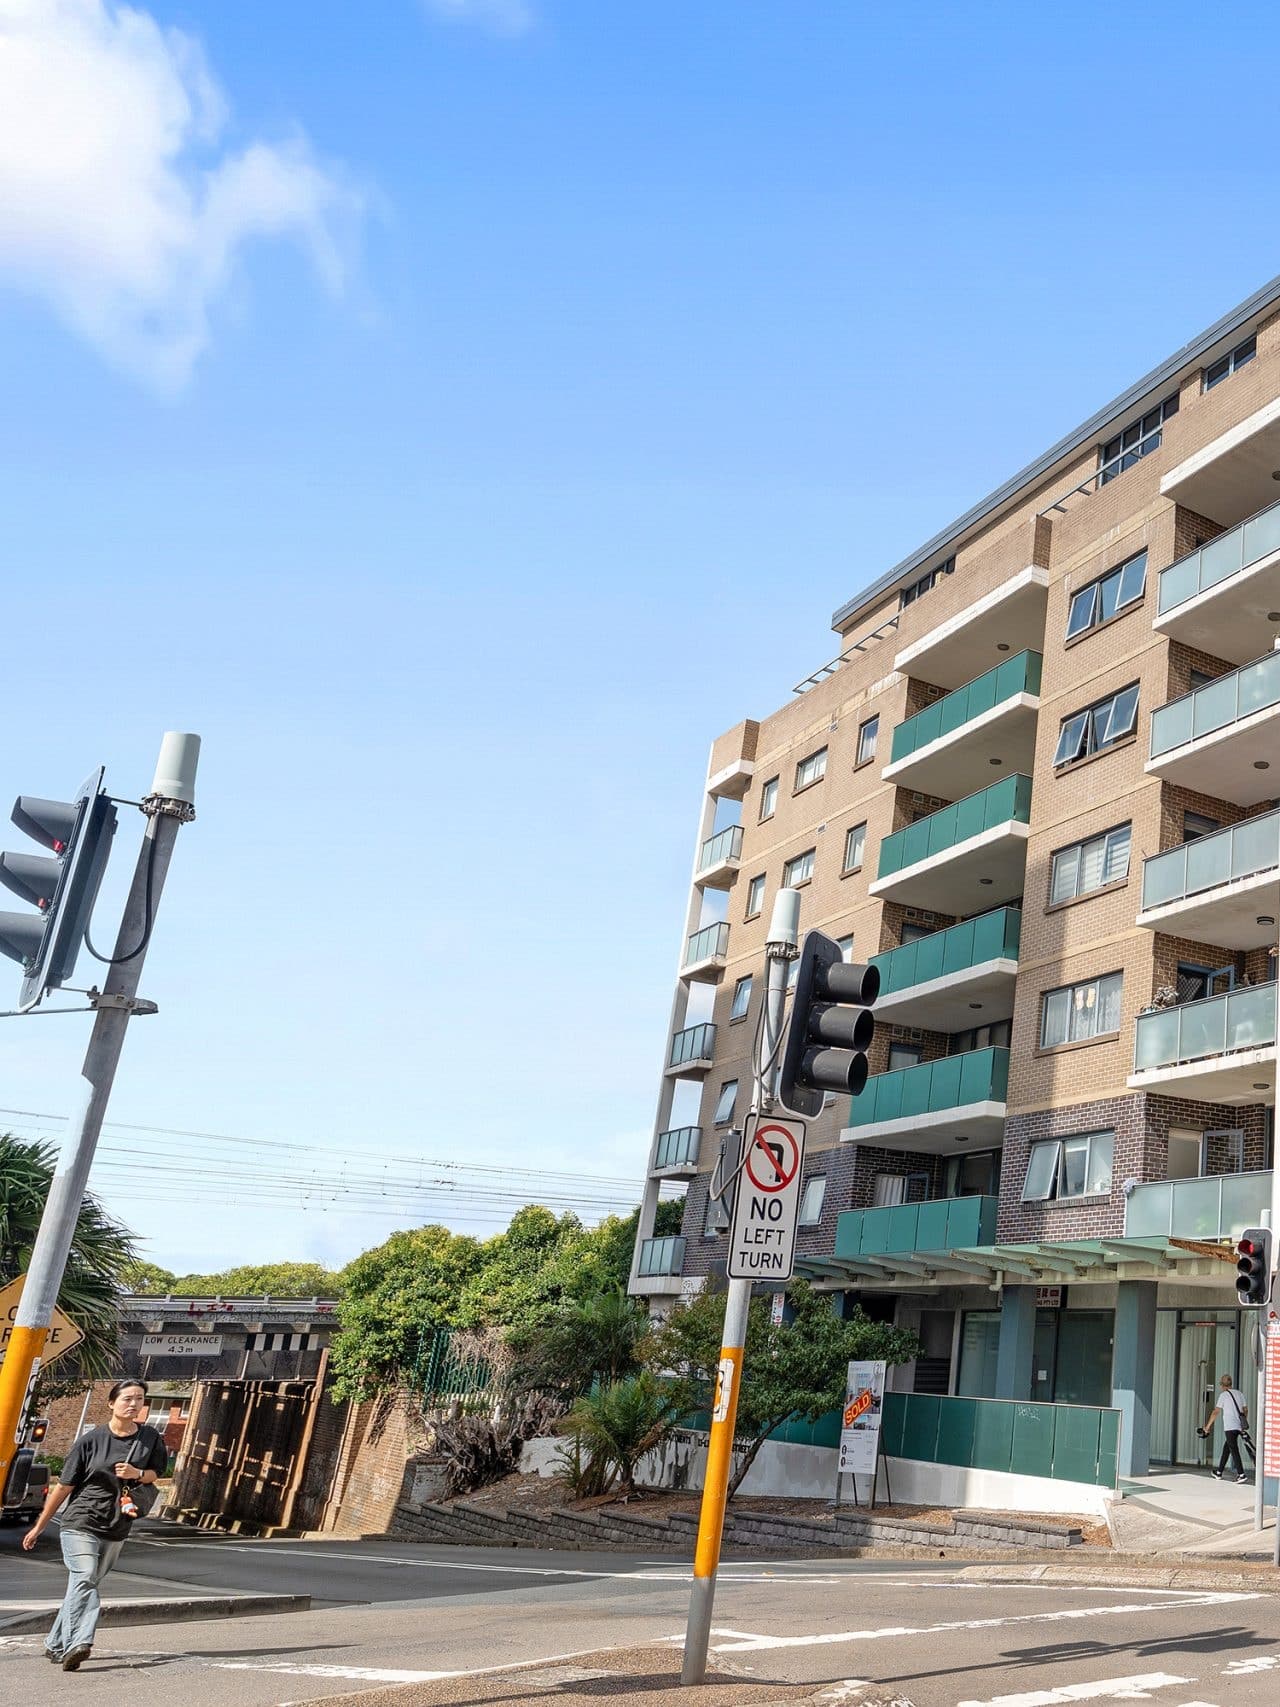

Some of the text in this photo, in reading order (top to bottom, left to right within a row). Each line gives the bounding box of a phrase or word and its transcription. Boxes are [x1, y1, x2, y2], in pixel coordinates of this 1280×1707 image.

[750, 1196, 783, 1222] NO
[743, 1227, 785, 1246] LEFT
[739, 1251, 784, 1270] TURN
[145, 1336, 219, 1344] LOW CLEARANCE
[845, 1393, 870, 1424] SOLD
